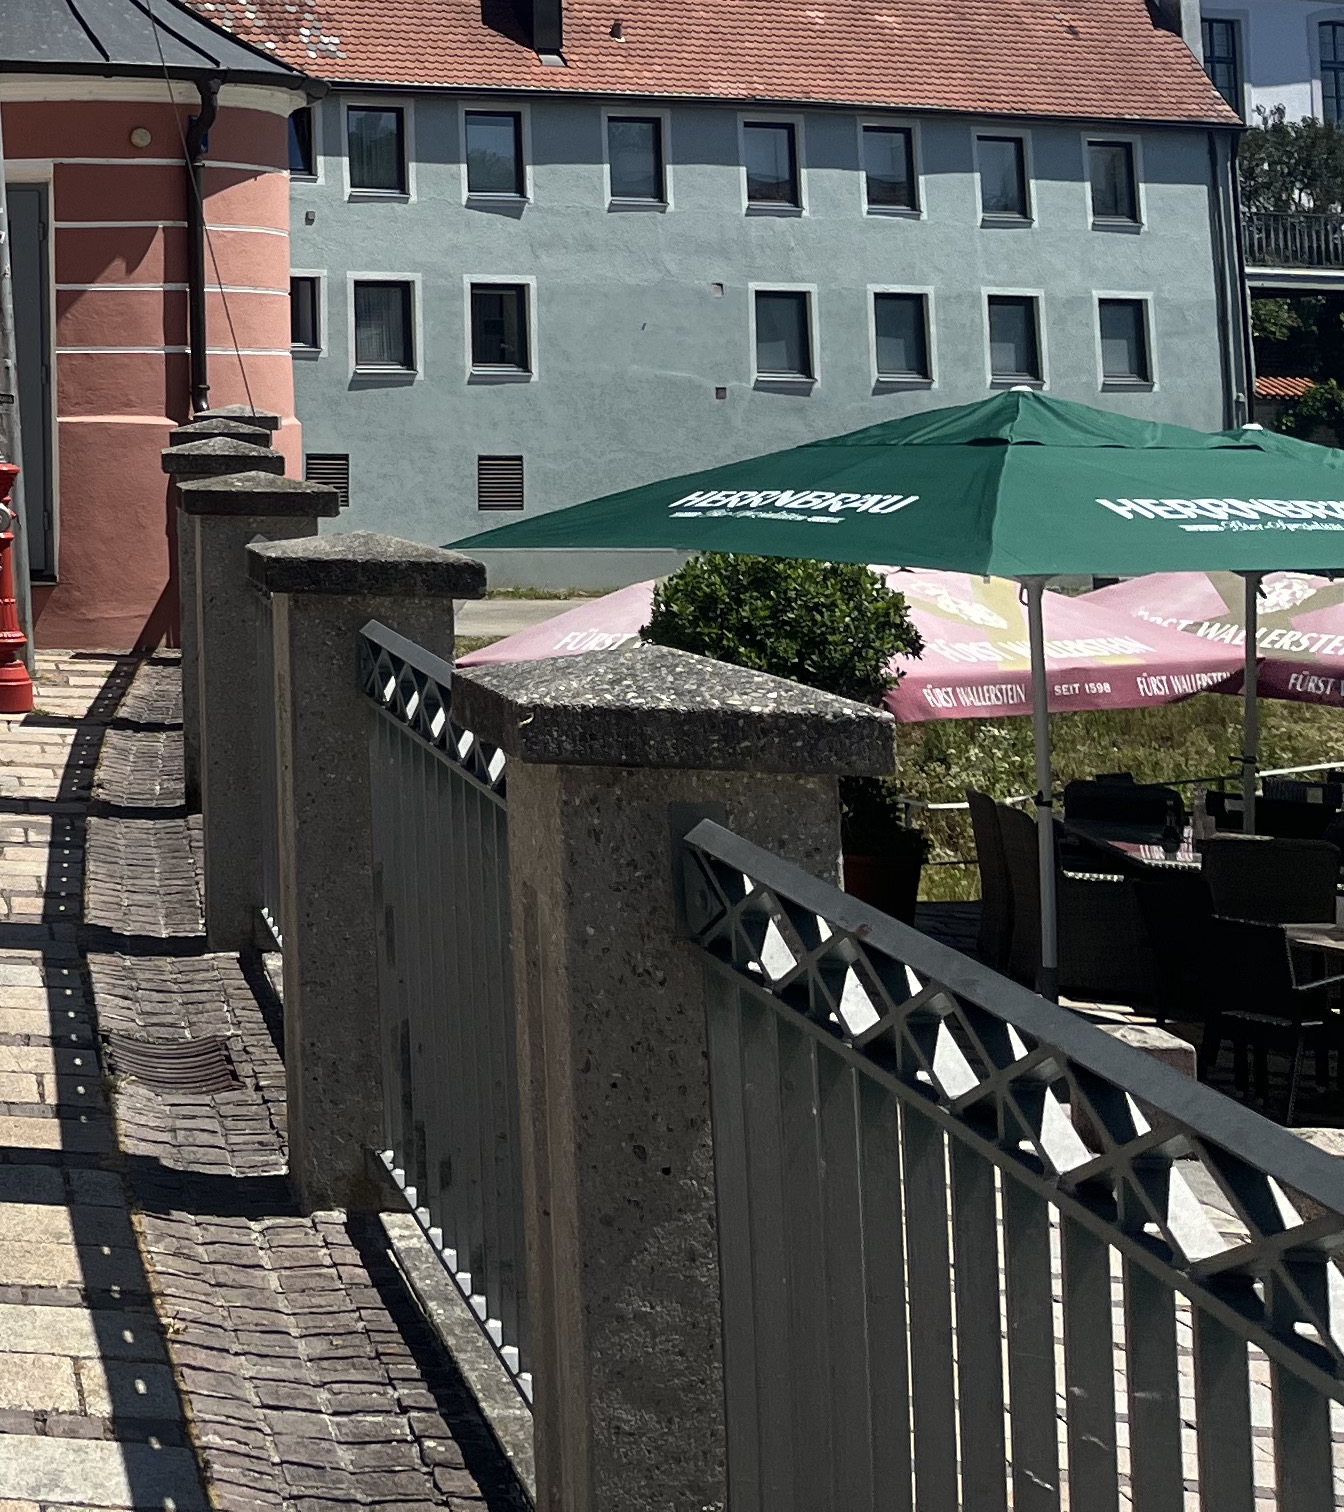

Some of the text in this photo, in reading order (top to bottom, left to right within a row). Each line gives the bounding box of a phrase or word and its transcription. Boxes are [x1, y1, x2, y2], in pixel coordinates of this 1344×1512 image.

[668, 489, 920, 514] HERRNBRÄU
[553, 627, 639, 651] FÜRST
[928, 636, 1157, 663] FÜRST WLLERSTEIN
[922, 684, 957, 708] FÜRST
[958, 684, 1026, 707] WALLERSTEIN
[1054, 685, 1080, 696] SEIT
[1085, 682, 1111, 694] 1598
[1136, 673, 1170, 697] FÜRST
[1289, 671, 1335, 695] FÜRST
